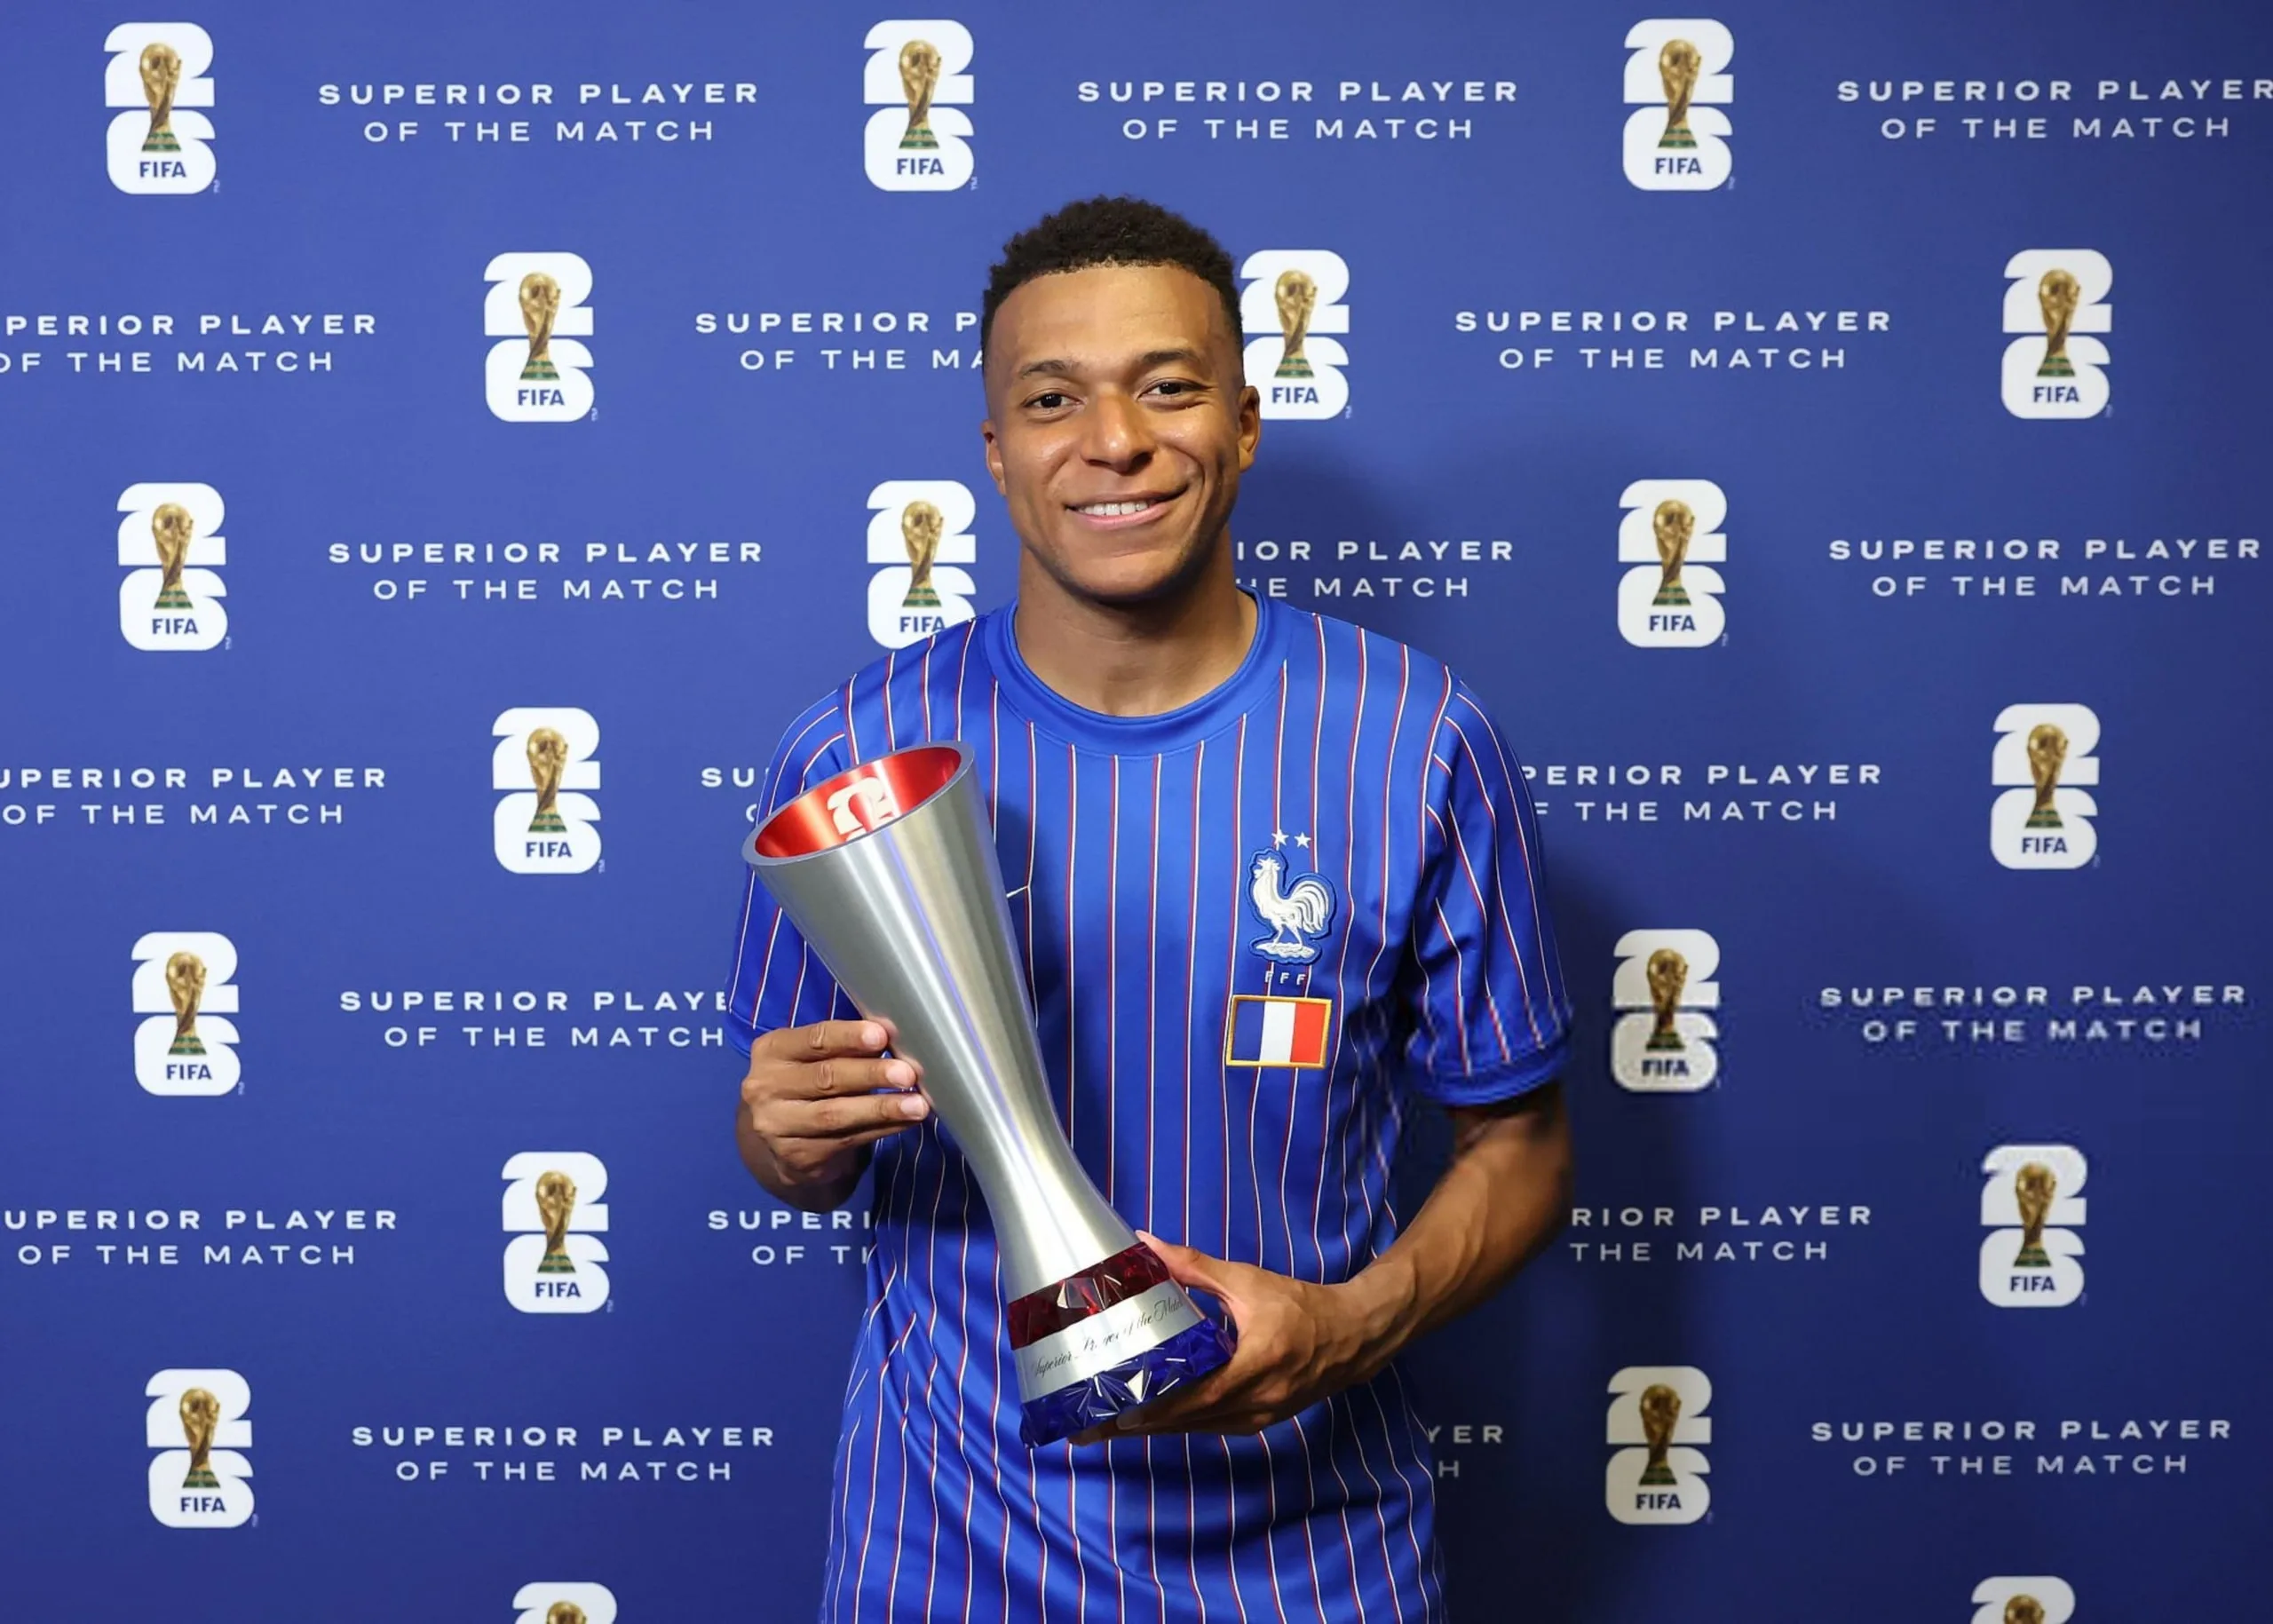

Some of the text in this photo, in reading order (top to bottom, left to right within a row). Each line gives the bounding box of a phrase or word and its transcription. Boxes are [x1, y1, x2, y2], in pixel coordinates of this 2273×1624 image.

[319, 83, 756, 105] SUPERIOR PLAYER
[1078, 82, 1517, 102] SUPERIOR PLAYER
[1838, 79, 2273, 101] SUPERIOR PLAYER
[364, 121, 711, 142] OF THE MATCH
[1123, 118, 1470, 139] OF THE MATCH
[1881, 117, 2229, 139] OF THE MATCH
[140, 162, 186, 178] FIFA
[898, 159, 943, 174] FIFA
[1656, 158, 1701, 174] FIFA
[6, 314, 375, 336] PERIOR PLAYER
[696, 313, 929, 333] SUPERIOR
[1455, 311, 1889, 332] SUPERIOR PLAYER
[67, 353, 151, 372] THE
[178, 352, 331, 372] MATCH
[741, 350, 906, 370] OF THE
[1500, 348, 1844, 368] OF THE MATCH
[519, 390, 564, 405] FIFA
[1272, 387, 1319, 403] FIFA
[2034, 386, 2079, 402] FIFA
[329, 543, 761, 563] SUPERIOR PLAYER
[1338, 541, 1512, 560] PLAYER
[1829, 539, 2260, 560] SUPERIOR PLAYER
[374, 579, 717, 599] OF THE MATCH
[1314, 577, 1468, 598] MATCH
[1872, 575, 2214, 597] OF THE MATCH
[153, 619, 198, 634] FIFA
[899, 616, 946, 632] FIFA
[1650, 615, 1695, 631] FIFA
[0, 768, 384, 788] PERIOR PLAYER
[1521, 764, 1881, 785] PERIOR PLAYER
[3, 804, 342, 825] OF THE MATCH
[1574, 801, 1835, 821] THE MATCH
[527, 842, 572, 857] FIFA
[2022, 837, 2067, 853] FIFA
[340, 991, 726, 1011] SUPERIOR PLAYE
[1820, 986, 2245, 1007] SUPERIOR PLAYER
[384, 1027, 723, 1047] OF THE MATCH
[1863, 1019, 2200, 1042] OF THE MATCH
[167, 1065, 211, 1080] FIFA
[1641, 1059, 1689, 1076] FIFA
[4, 1210, 396, 1230] UPERIOR PLAYER
[709, 1210, 870, 1230] SUPERI
[1572, 1206, 1871, 1226] RIOR PLAYER
[18, 1245, 353, 1264] OF THE MATCH
[752, 1246, 804, 1265] OF
[1570, 1241, 1826, 1261] THE MATCH
[535, 1282, 581, 1297] FIFA
[2010, 1275, 2055, 1292] FIFA
[352, 1427, 773, 1446] SUPERIOR PLAYER
[1428, 1425, 1503, 1444] YER
[1811, 1420, 2230, 1441] SUPERIOR PLAYER
[396, 1462, 731, 1481] OF THE MATCH
[1853, 1454, 2186, 1476] OF THE MATCH
[181, 1497, 226, 1512] FIFA
[1635, 1493, 1683, 1511] FIFA
